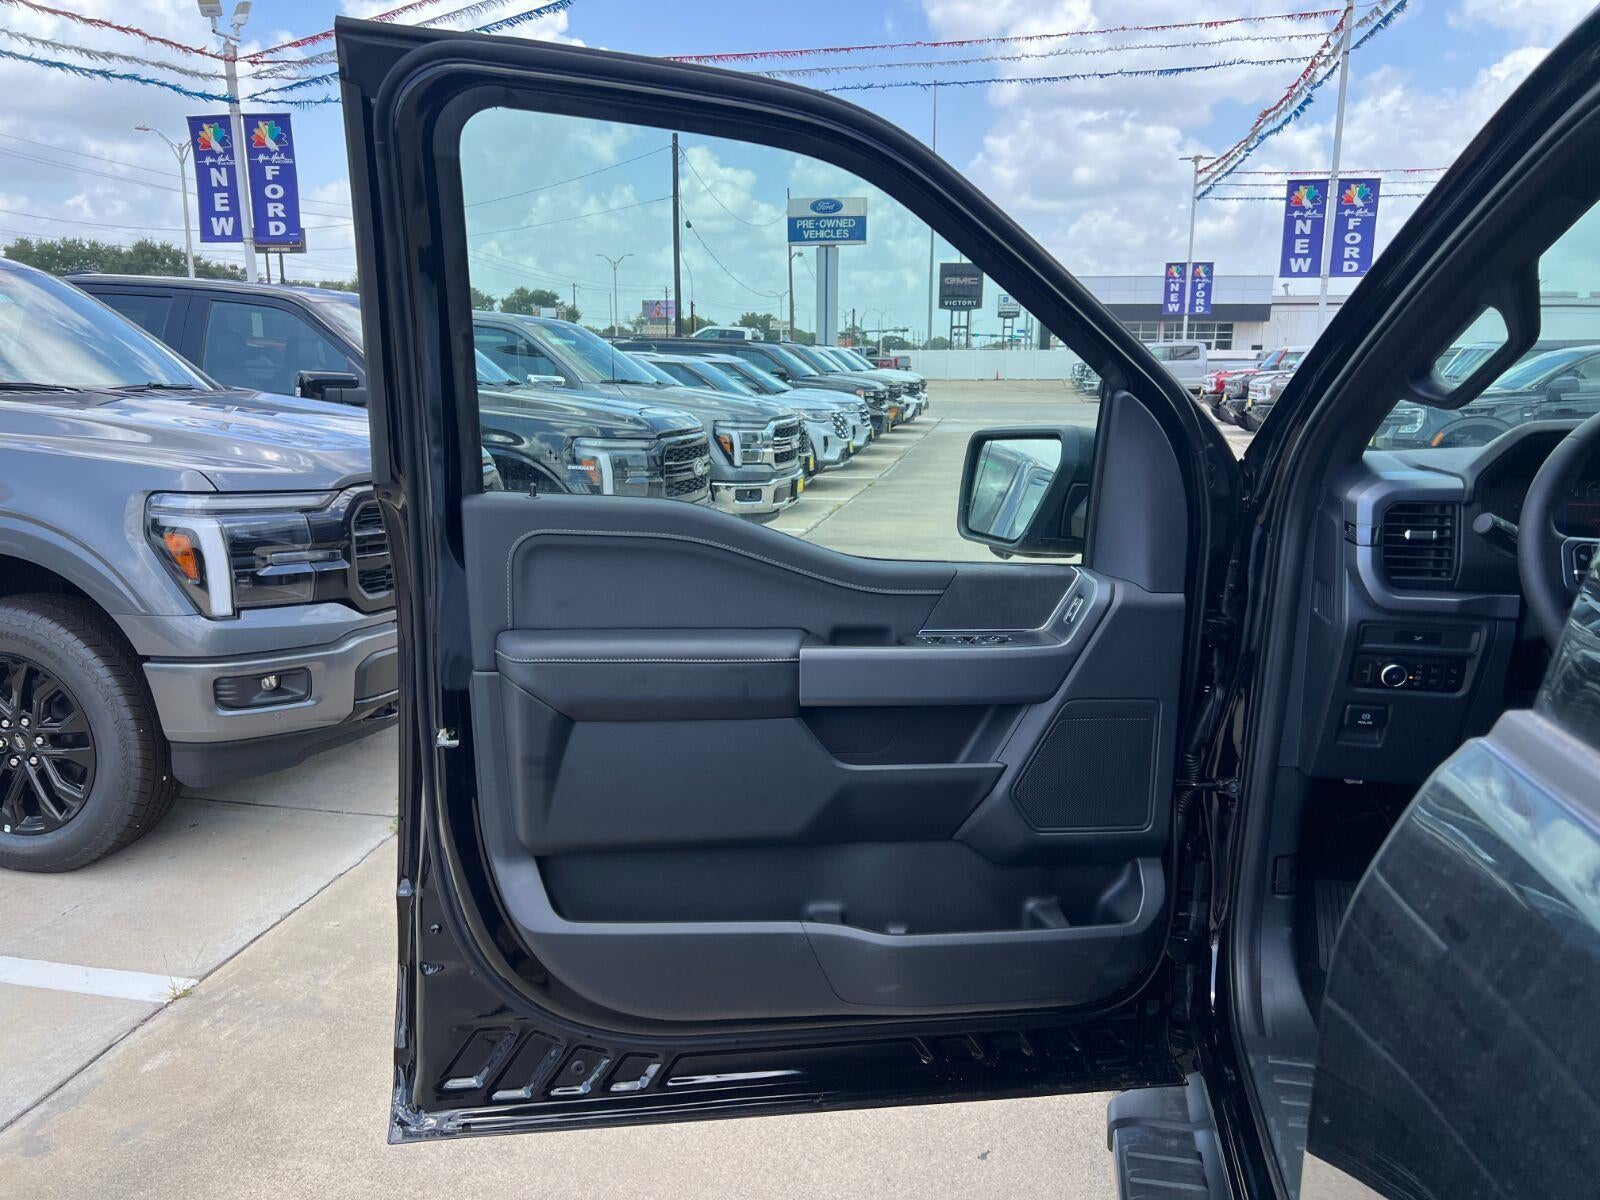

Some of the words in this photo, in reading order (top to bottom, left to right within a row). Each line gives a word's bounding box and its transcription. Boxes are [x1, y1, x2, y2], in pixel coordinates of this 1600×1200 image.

[210, 167, 234, 236] NEW
[264, 166, 287, 236] FORD
[803, 229, 849, 239] VEHICLES
[1290, 219, 1312, 273] NEW
[1343, 218, 1362, 273] FORD
[944, 277, 978, 285] GMC
[1169, 283, 1180, 312] NEW
[1195, 284, 1205, 312] FORD
